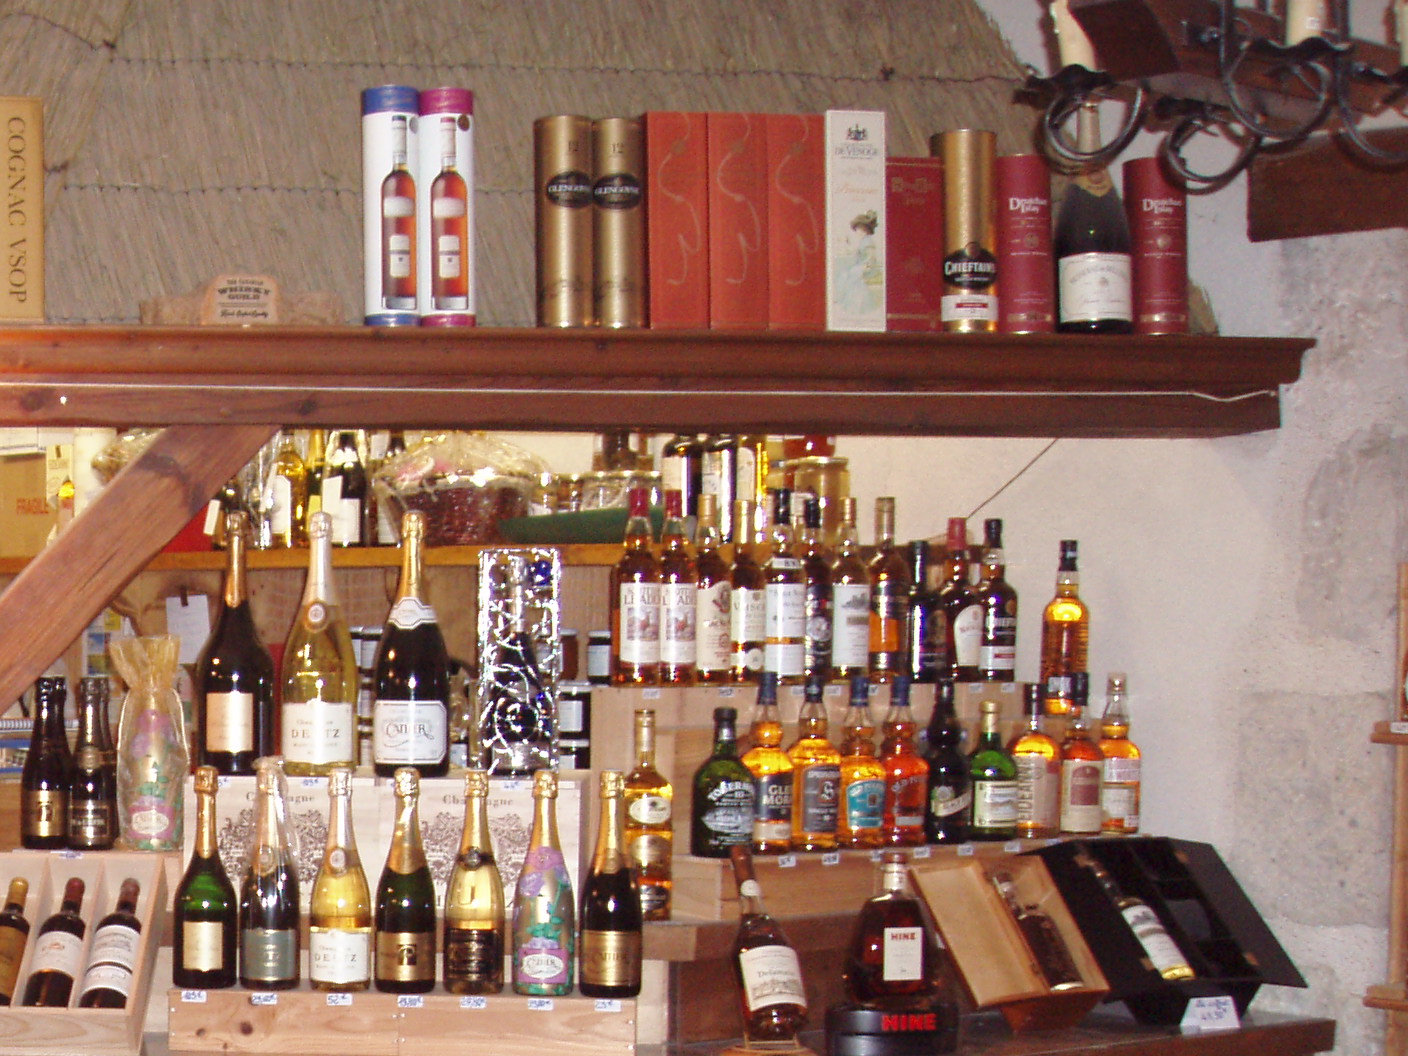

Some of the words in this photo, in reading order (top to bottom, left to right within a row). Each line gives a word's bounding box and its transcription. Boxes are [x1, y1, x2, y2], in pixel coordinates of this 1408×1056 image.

[7, 116, 30, 227] COGNAC
[8, 233, 28, 303] VSOP
[768, 785, 793, 795] GLE
[890, 932, 917, 941] HINE
[881, 1012, 937, 1031] HINE
